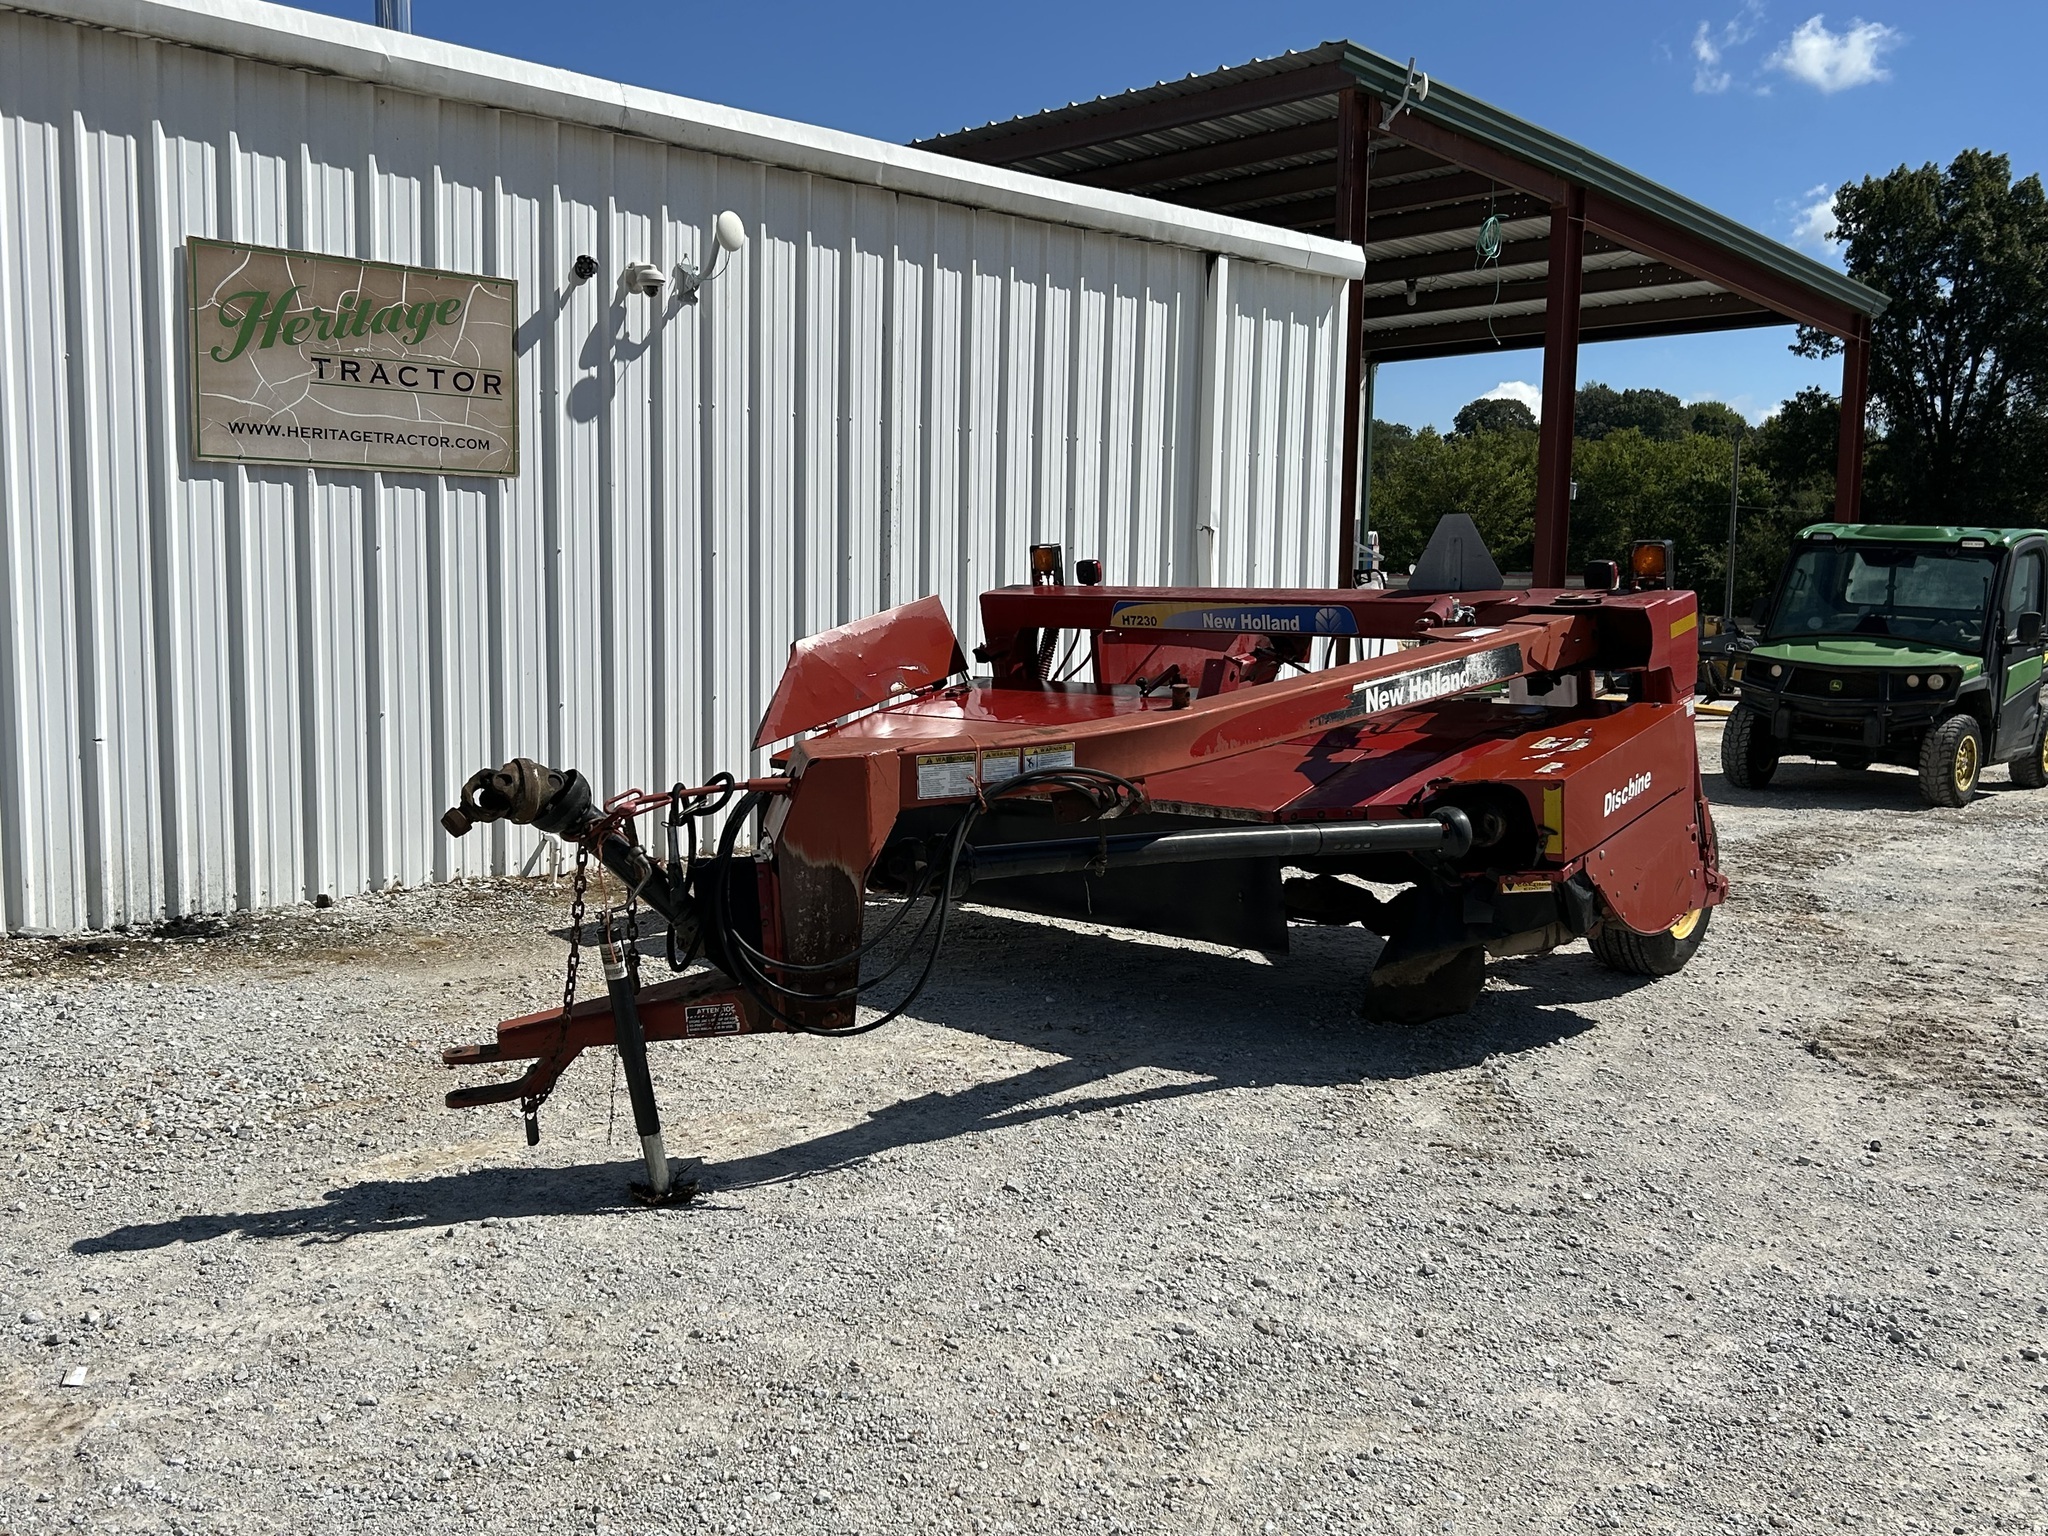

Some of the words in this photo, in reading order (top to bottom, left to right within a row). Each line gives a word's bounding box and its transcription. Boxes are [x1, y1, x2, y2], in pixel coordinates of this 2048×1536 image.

[210, 285, 466, 363] Heritage
[310, 357, 502, 395] TRACTOR
[228, 421, 491, 451] WWW.HERITAGETRACTOR.COM
[1121, 615, 1157, 627] H7230
[1202, 612, 1236, 629] New
[1240, 613, 1300, 632] Holland
[1365, 685, 1405, 714] New
[1409, 668, 1471, 703] Holland
